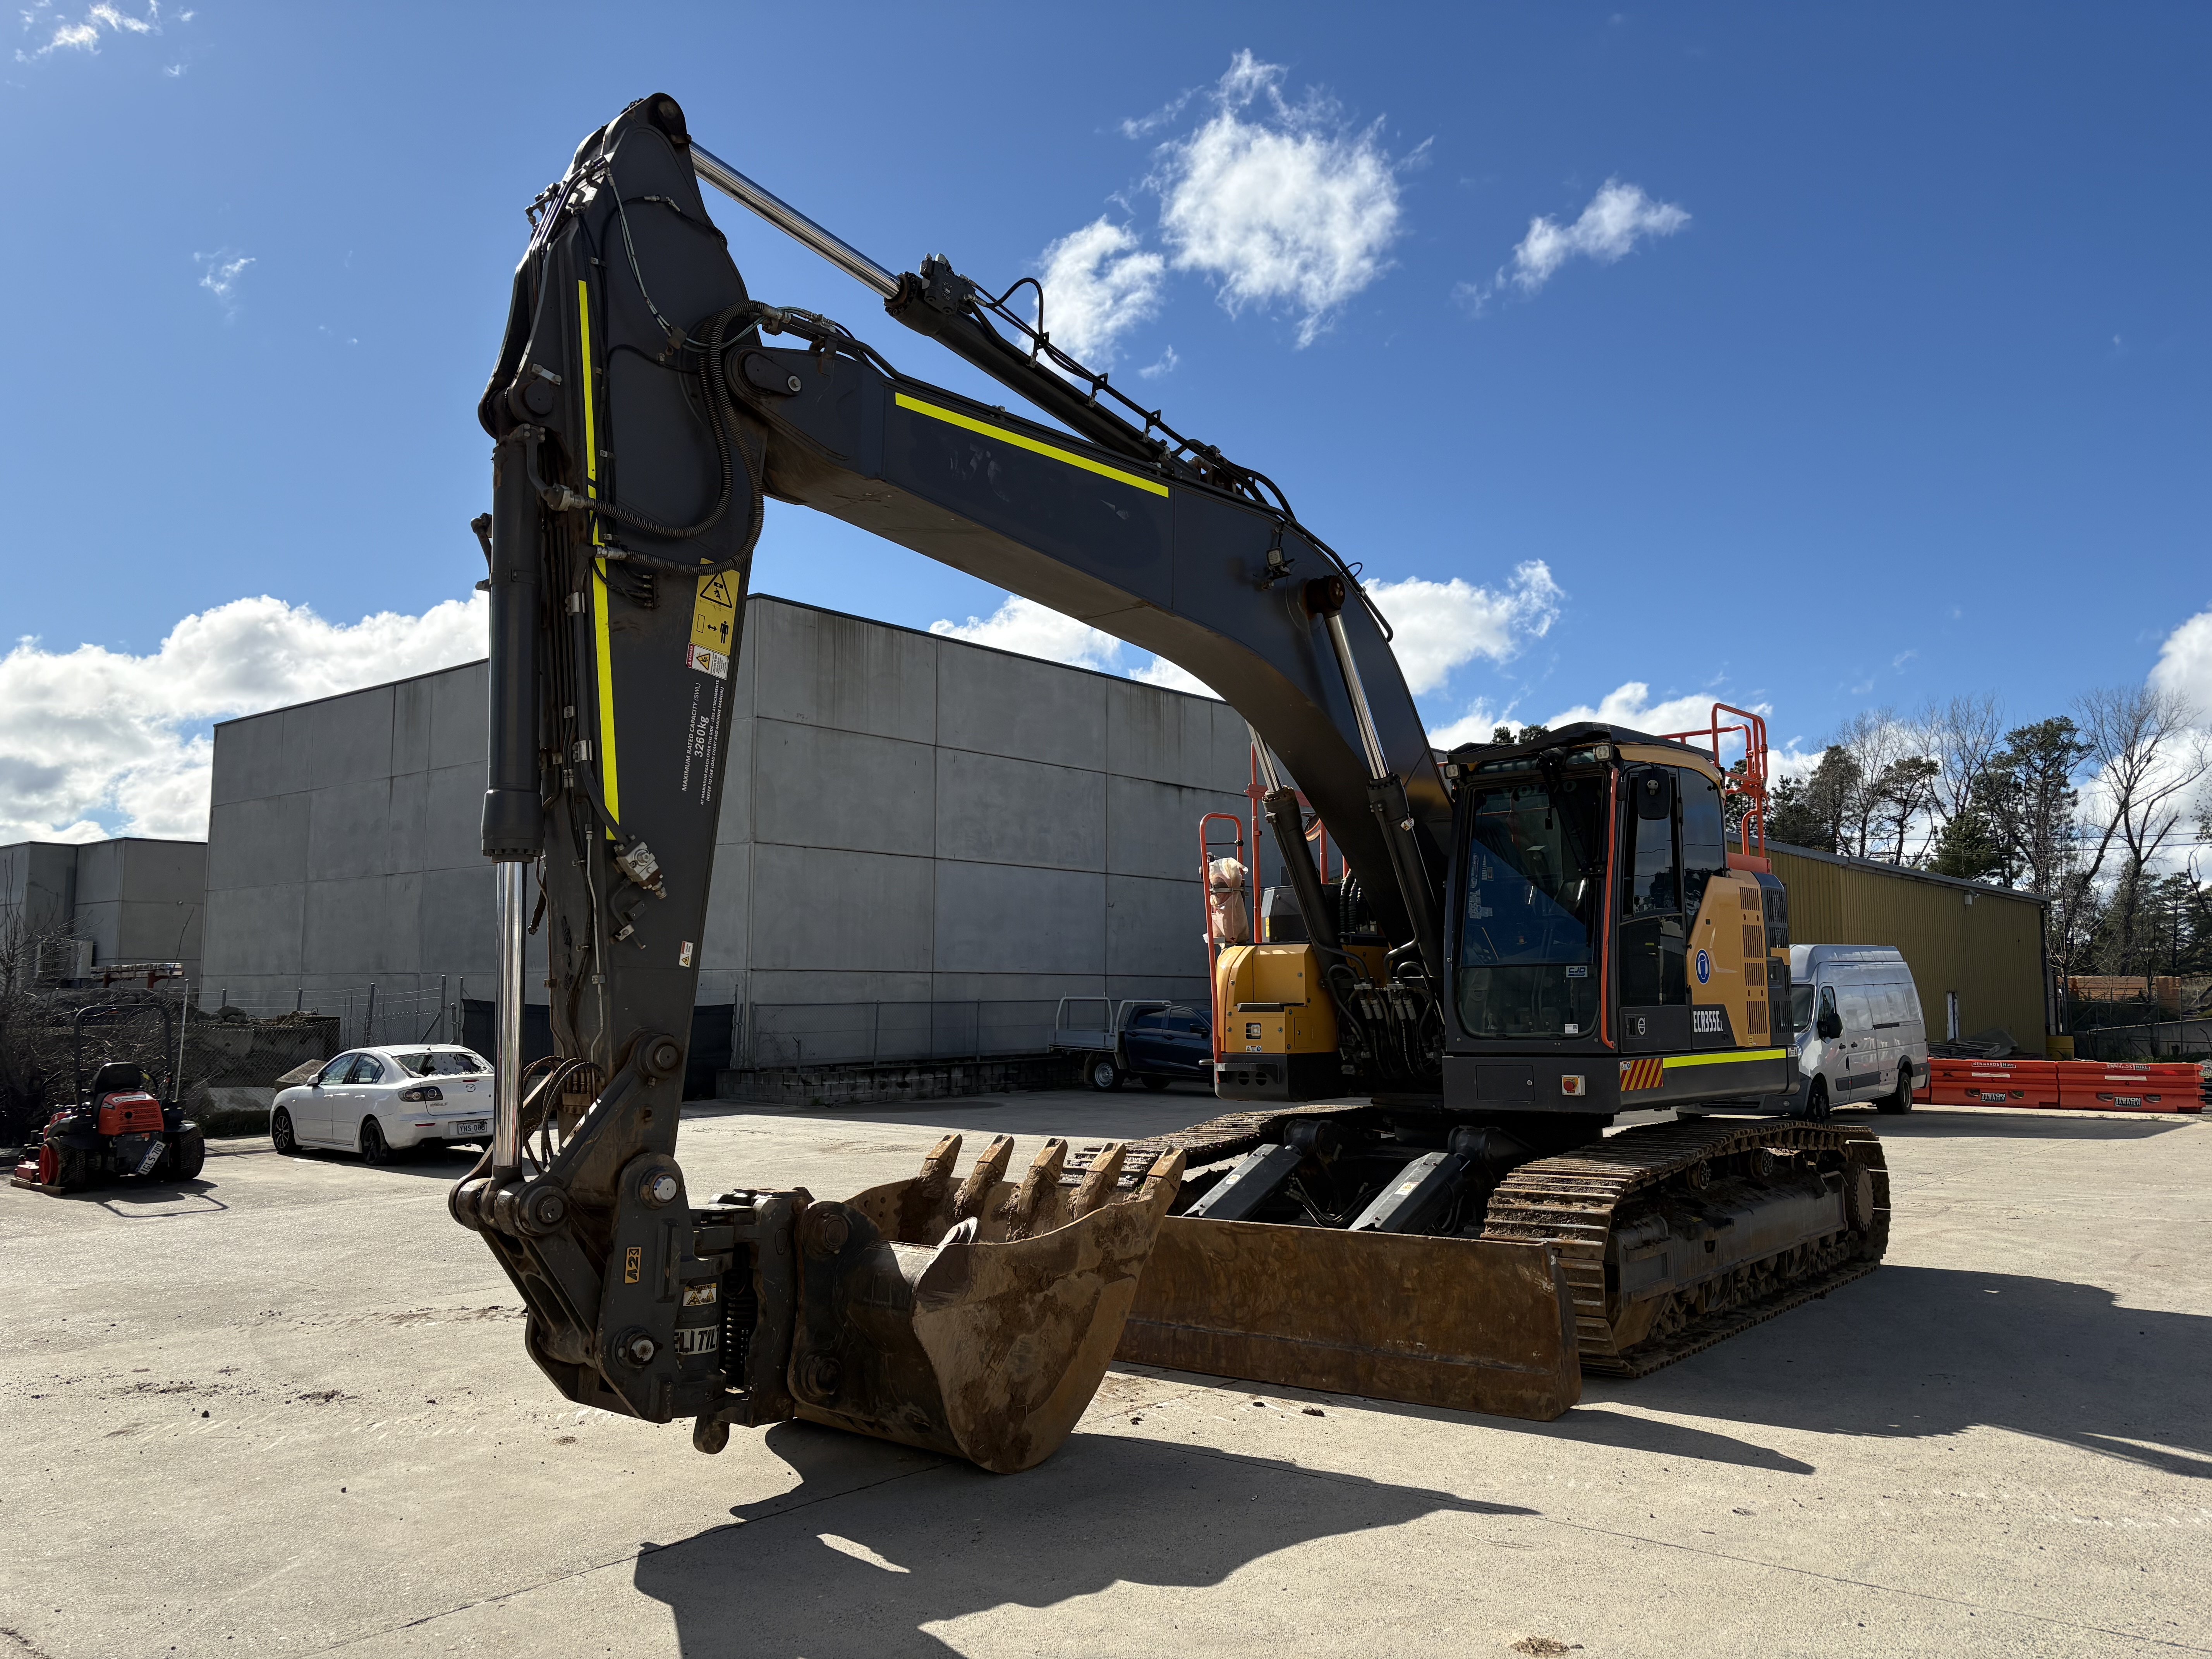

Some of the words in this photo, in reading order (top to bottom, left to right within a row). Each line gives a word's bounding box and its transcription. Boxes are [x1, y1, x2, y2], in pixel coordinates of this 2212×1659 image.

[682, 755, 691, 791] MAXIMUM
[690, 701, 698, 732] CAPACITY
[694, 715, 709, 757] 3260kg
